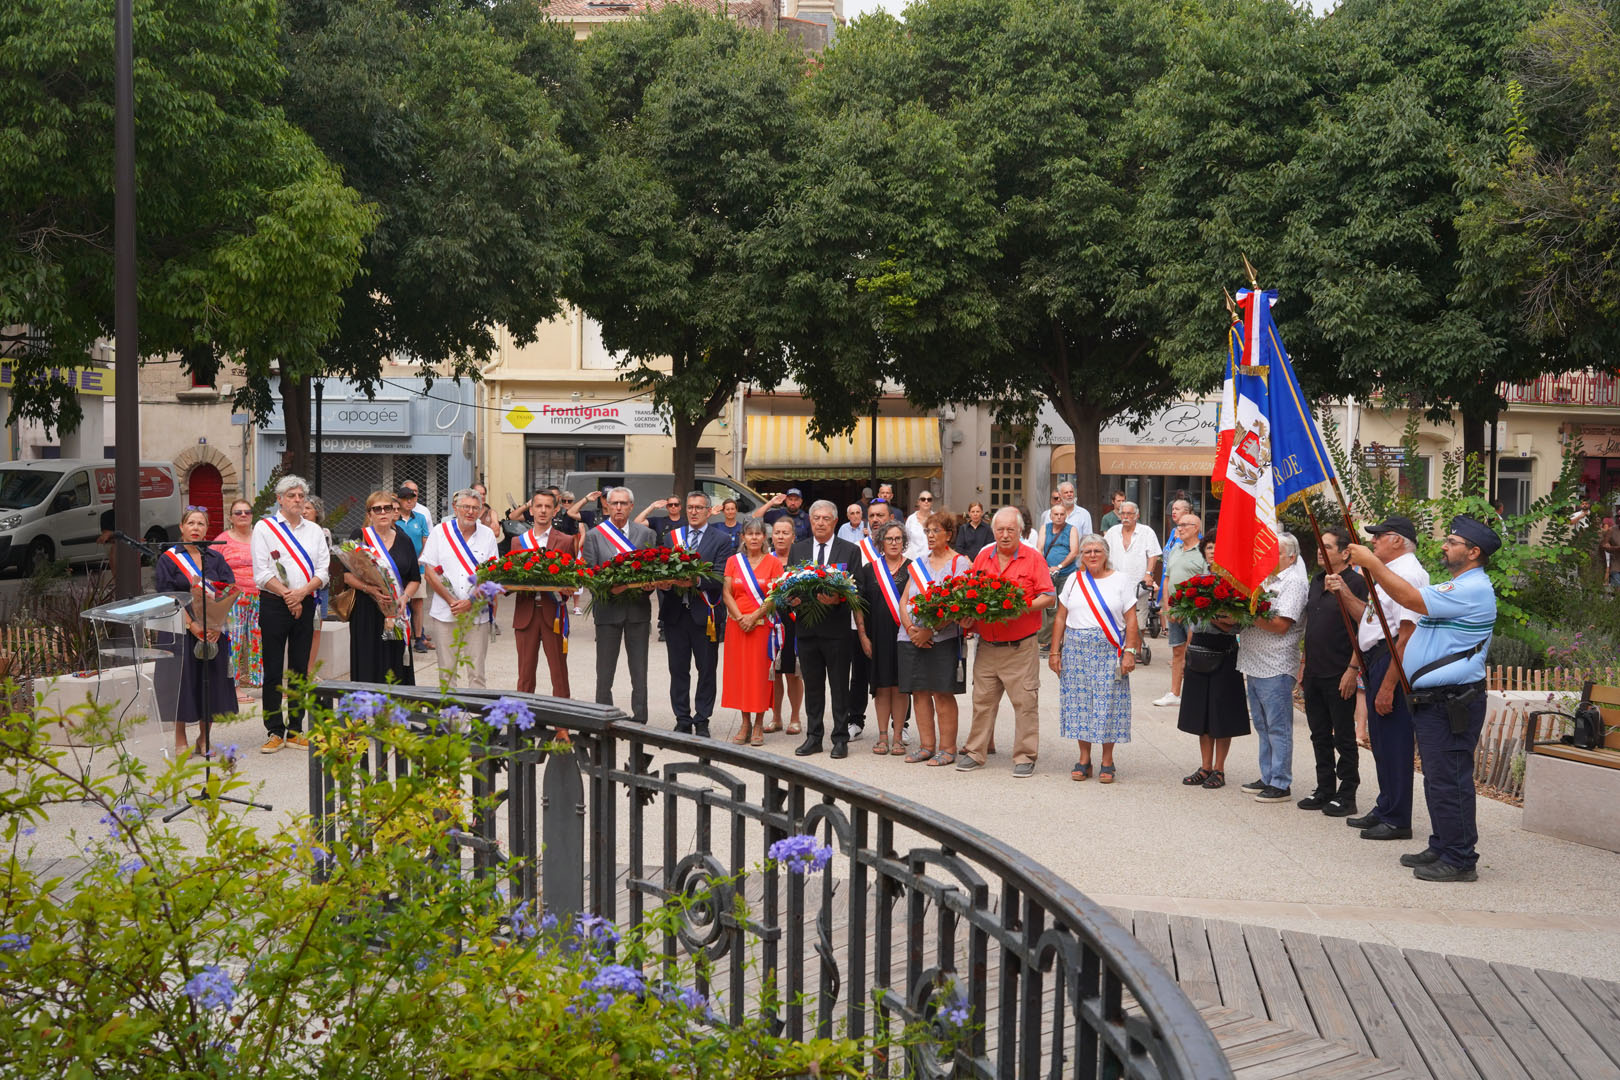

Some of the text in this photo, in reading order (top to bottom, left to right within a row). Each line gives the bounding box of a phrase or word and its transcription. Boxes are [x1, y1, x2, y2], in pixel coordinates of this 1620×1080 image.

[338, 407, 398, 425] apogée
[543, 404, 619, 420] Frontignan
[550, 416, 581, 425] immo
[341, 439, 372, 450] yoga
[1112, 460, 1124, 470] LA
[784, 468, 826, 479] FRUITS
